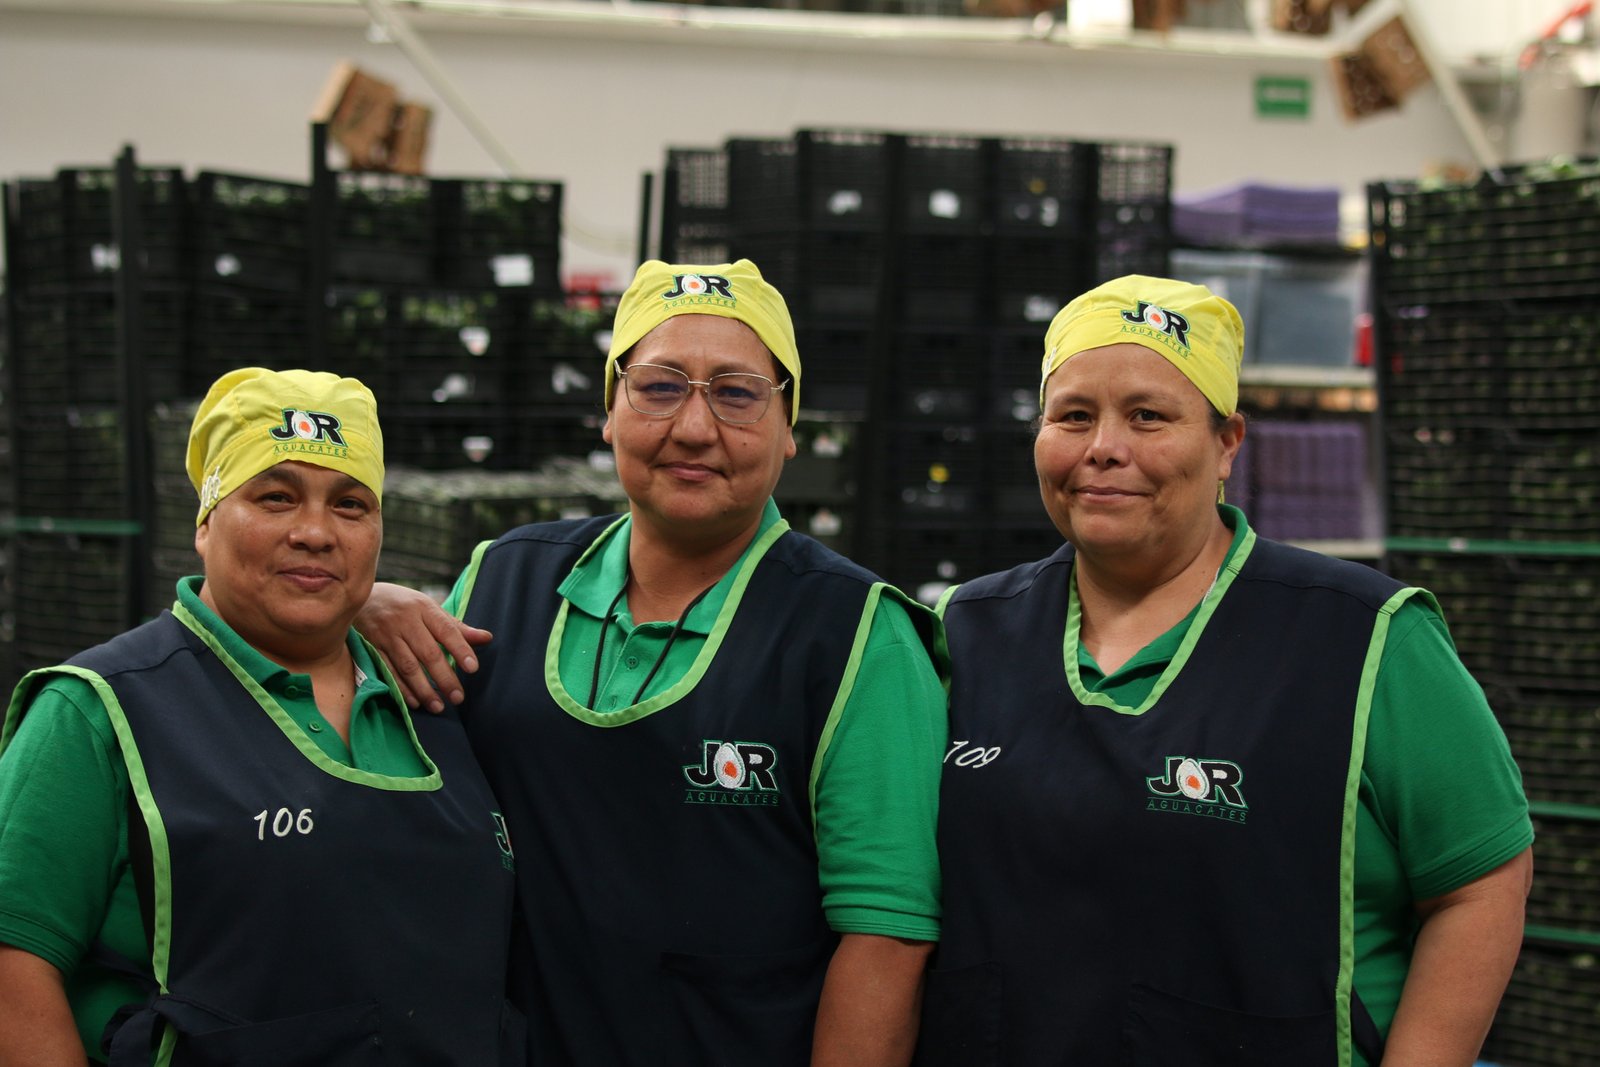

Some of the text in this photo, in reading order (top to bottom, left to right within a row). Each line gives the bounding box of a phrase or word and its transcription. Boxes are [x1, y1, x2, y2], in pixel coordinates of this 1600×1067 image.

[1120, 325, 1189, 358] AGUACATES
[274, 443, 347, 457] AGUACATES
[686, 792, 778, 804] AGUACATES
[1147, 799, 1246, 821] AGUACATES
[254, 807, 313, 840] 106
